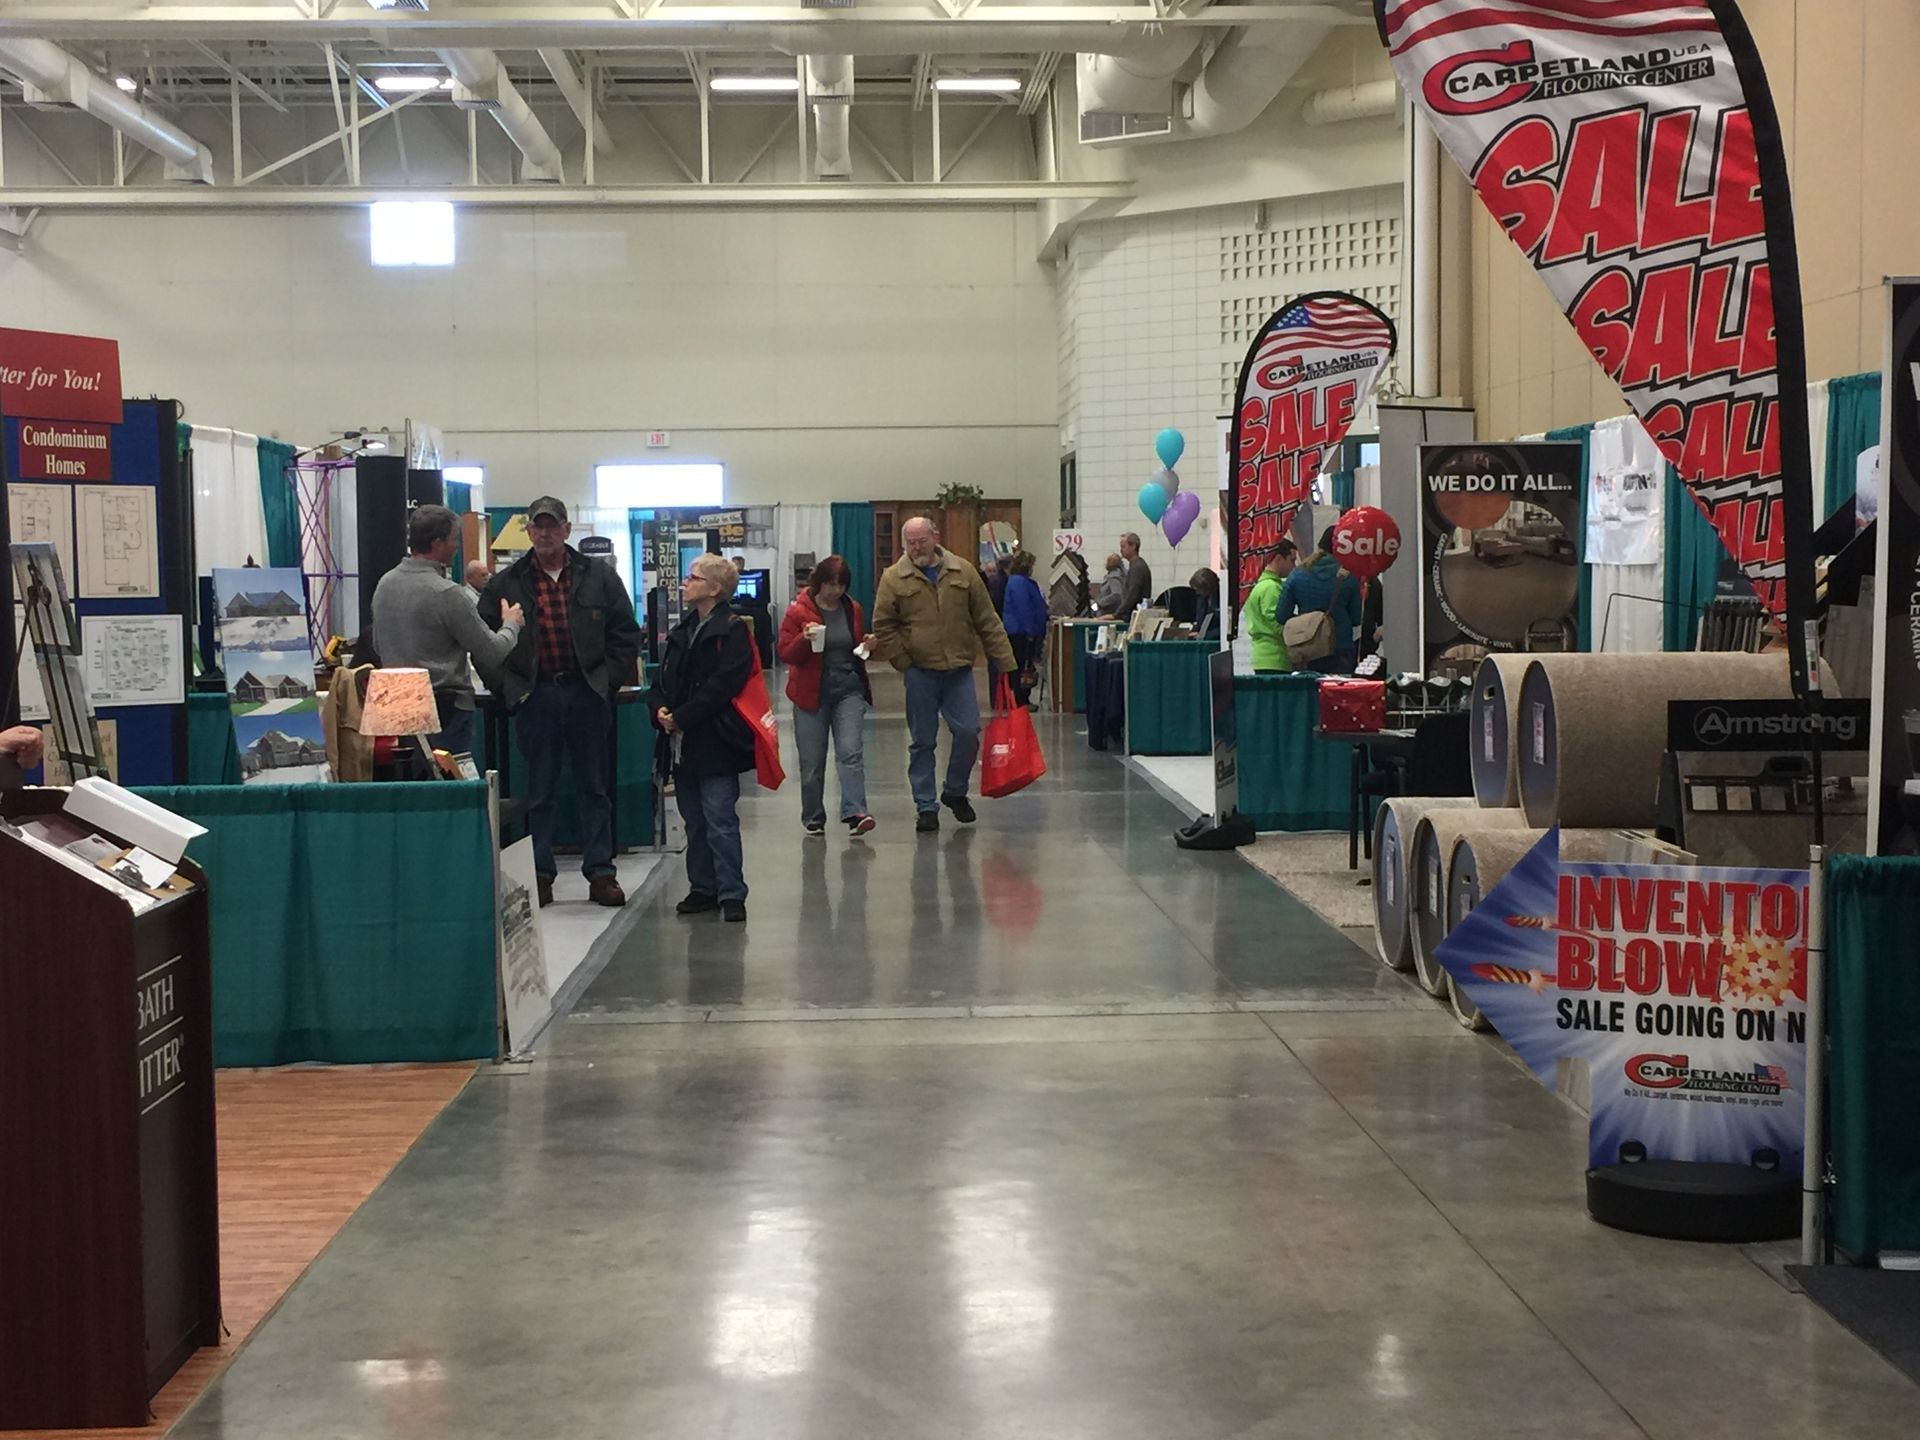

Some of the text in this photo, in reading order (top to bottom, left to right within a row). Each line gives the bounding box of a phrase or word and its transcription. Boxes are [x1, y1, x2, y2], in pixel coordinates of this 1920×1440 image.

[1440, 43, 1712, 101] CARPETLAND USA
[1544, 62, 1710, 98] FLOORING CENTER
[26, 366, 57, 391] for
[63, 368, 101, 391] You!
[1265, 353, 1361, 384] CARPETLAND
[23, 424, 107, 449] Condominium
[1239, 379, 1357, 464] SALE
[45, 454, 86, 476] Homes
[1428, 474, 1573, 492] WE DO IT ALL...
[1336, 528, 1399, 557] Sale
[1694, 707, 1858, 744] Armstrong
[1557, 874, 1809, 940] INVENTO
[1556, 997, 1625, 1033] SALE
[1635, 1002, 1725, 1039] GOING
[1735, 1008, 1776, 1042] ON
[1634, 1059, 1766, 1084] CARPETLAND
[1688, 1079, 1778, 1095] FLOORING CENTER
